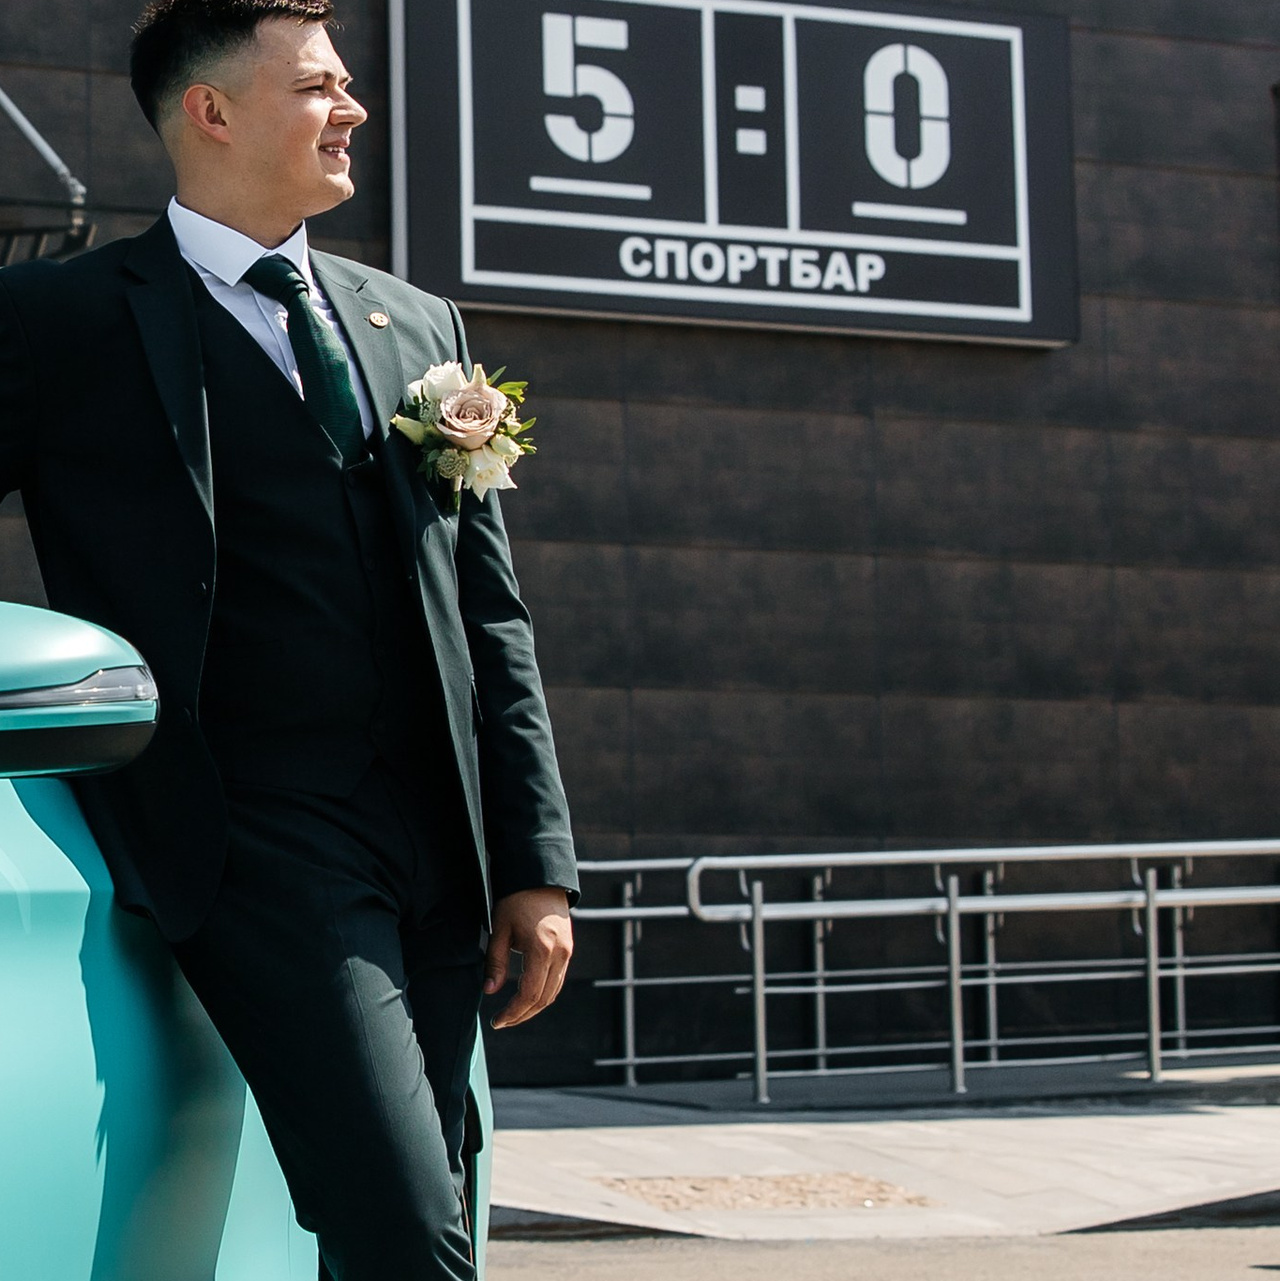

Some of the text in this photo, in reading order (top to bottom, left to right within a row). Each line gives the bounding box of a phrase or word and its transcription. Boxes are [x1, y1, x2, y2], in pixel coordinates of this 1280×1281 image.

[542, 11, 635, 163] 5
[863, 42, 951, 189] 0
[618, 235, 887, 294] СПОРТБАР
